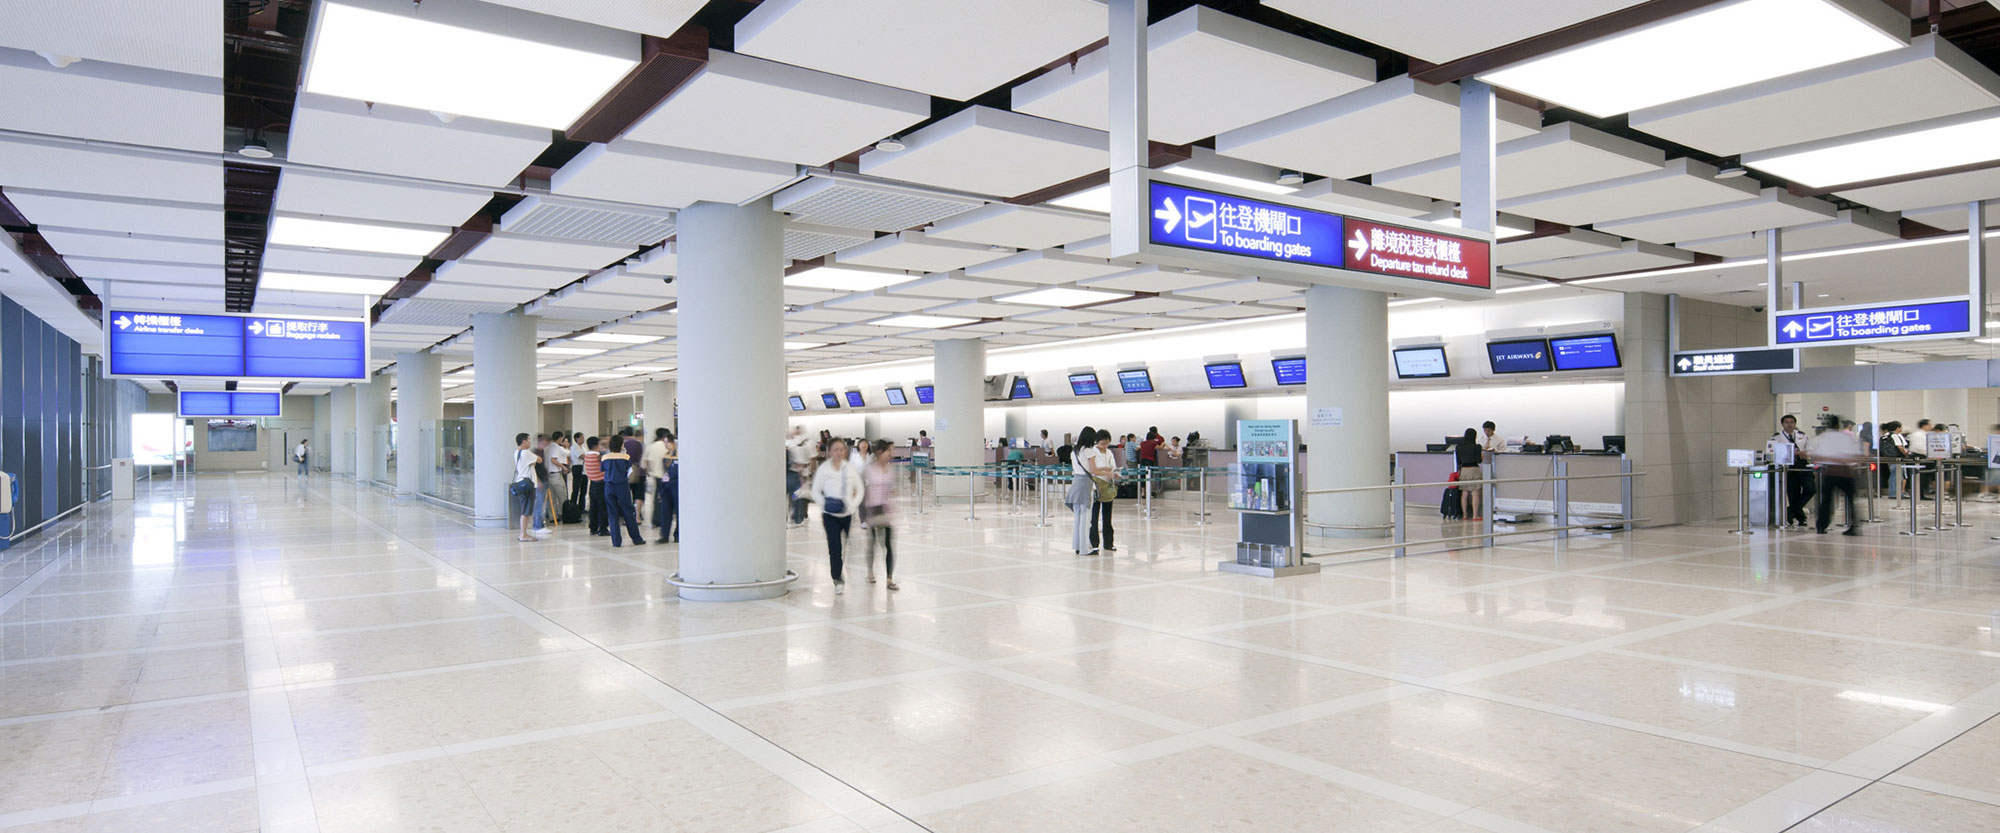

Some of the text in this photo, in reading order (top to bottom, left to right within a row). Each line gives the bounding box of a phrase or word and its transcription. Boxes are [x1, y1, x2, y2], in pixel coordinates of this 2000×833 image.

[1219, 202, 1301, 236] 往登機閘口
[1219, 230, 1312, 258] To boarding gates
[1370, 253, 1468, 280] Departure tax refund desk
[1836, 309, 1920, 328] 往登機閘口
[133, 325, 204, 335] Airline transfer desks
[286, 321, 328, 332] 提取行李
[1836, 323, 1932, 337] To boarding gates
[286, 331, 341, 340] Baggage reclaim
[1693, 363, 1734, 372] Staff channel
